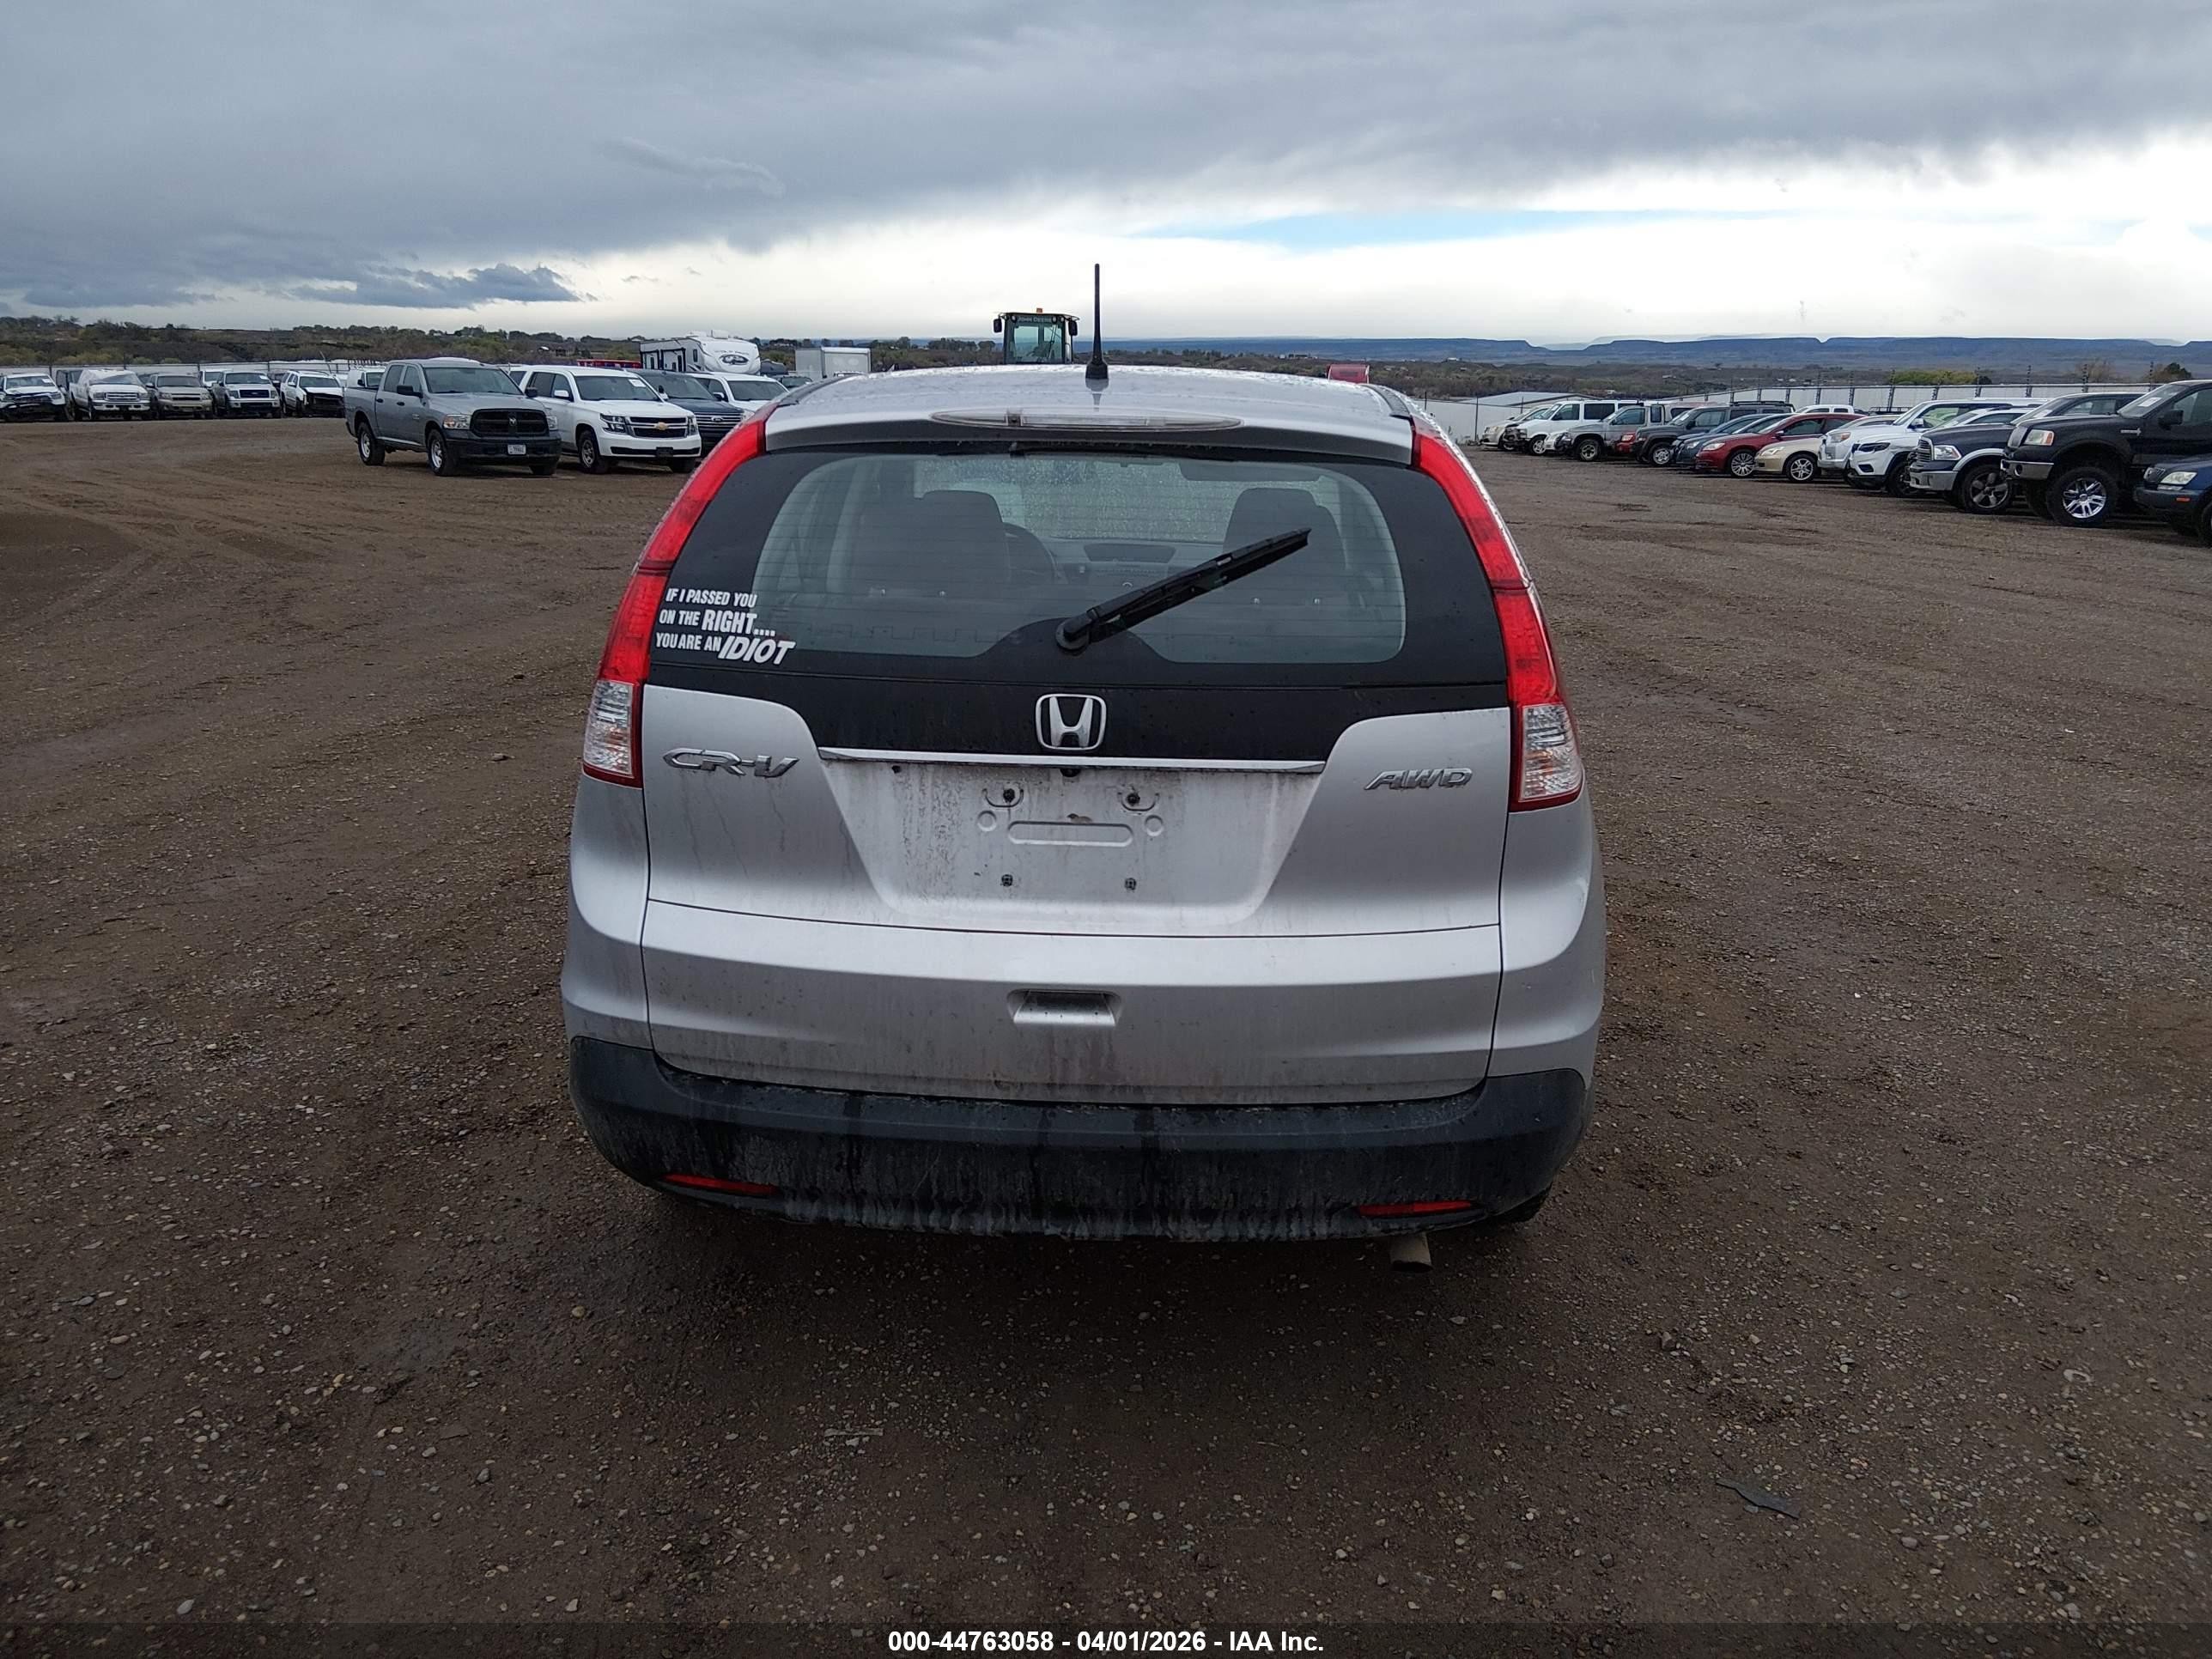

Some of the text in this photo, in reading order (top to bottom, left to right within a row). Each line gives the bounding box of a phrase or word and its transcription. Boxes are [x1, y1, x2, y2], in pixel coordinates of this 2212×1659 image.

[665, 588, 758, 608] IF I PASSED YOU
[659, 609, 676, 624] ON
[678, 611, 701, 626] THE
[655, 632, 796, 665] YOU ARE AN IDIOT
[662, 747, 800, 778] CR-V
[1363, 767, 1474, 791] AWD
